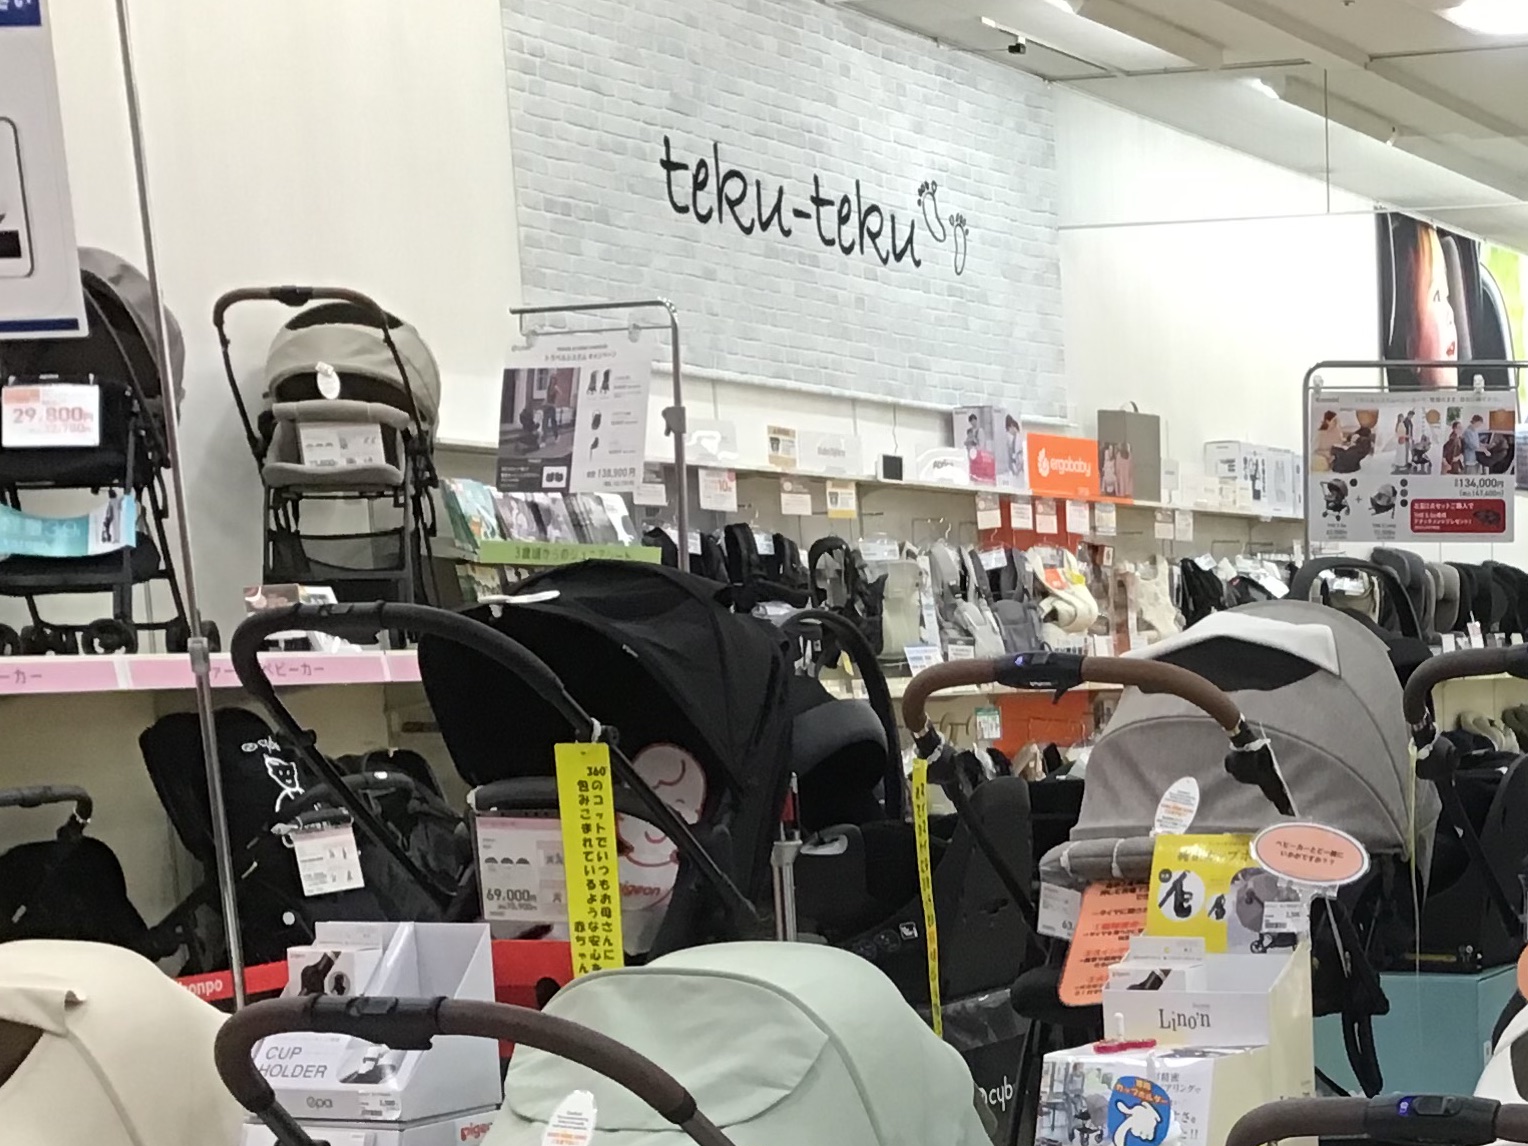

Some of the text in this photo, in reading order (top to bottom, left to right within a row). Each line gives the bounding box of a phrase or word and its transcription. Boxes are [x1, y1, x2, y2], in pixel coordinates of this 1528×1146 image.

[660, 134, 922, 268] teku-teku
[12, 406, 94, 424] 29,800円
[1050, 460, 1092, 477] ergobaby
[619, 881, 661, 897] igeon
[1159, 1008, 1212, 1032] Lino'n
[265, 1046, 303, 1060] CUP
[258, 1064, 328, 1079] HOLDER
